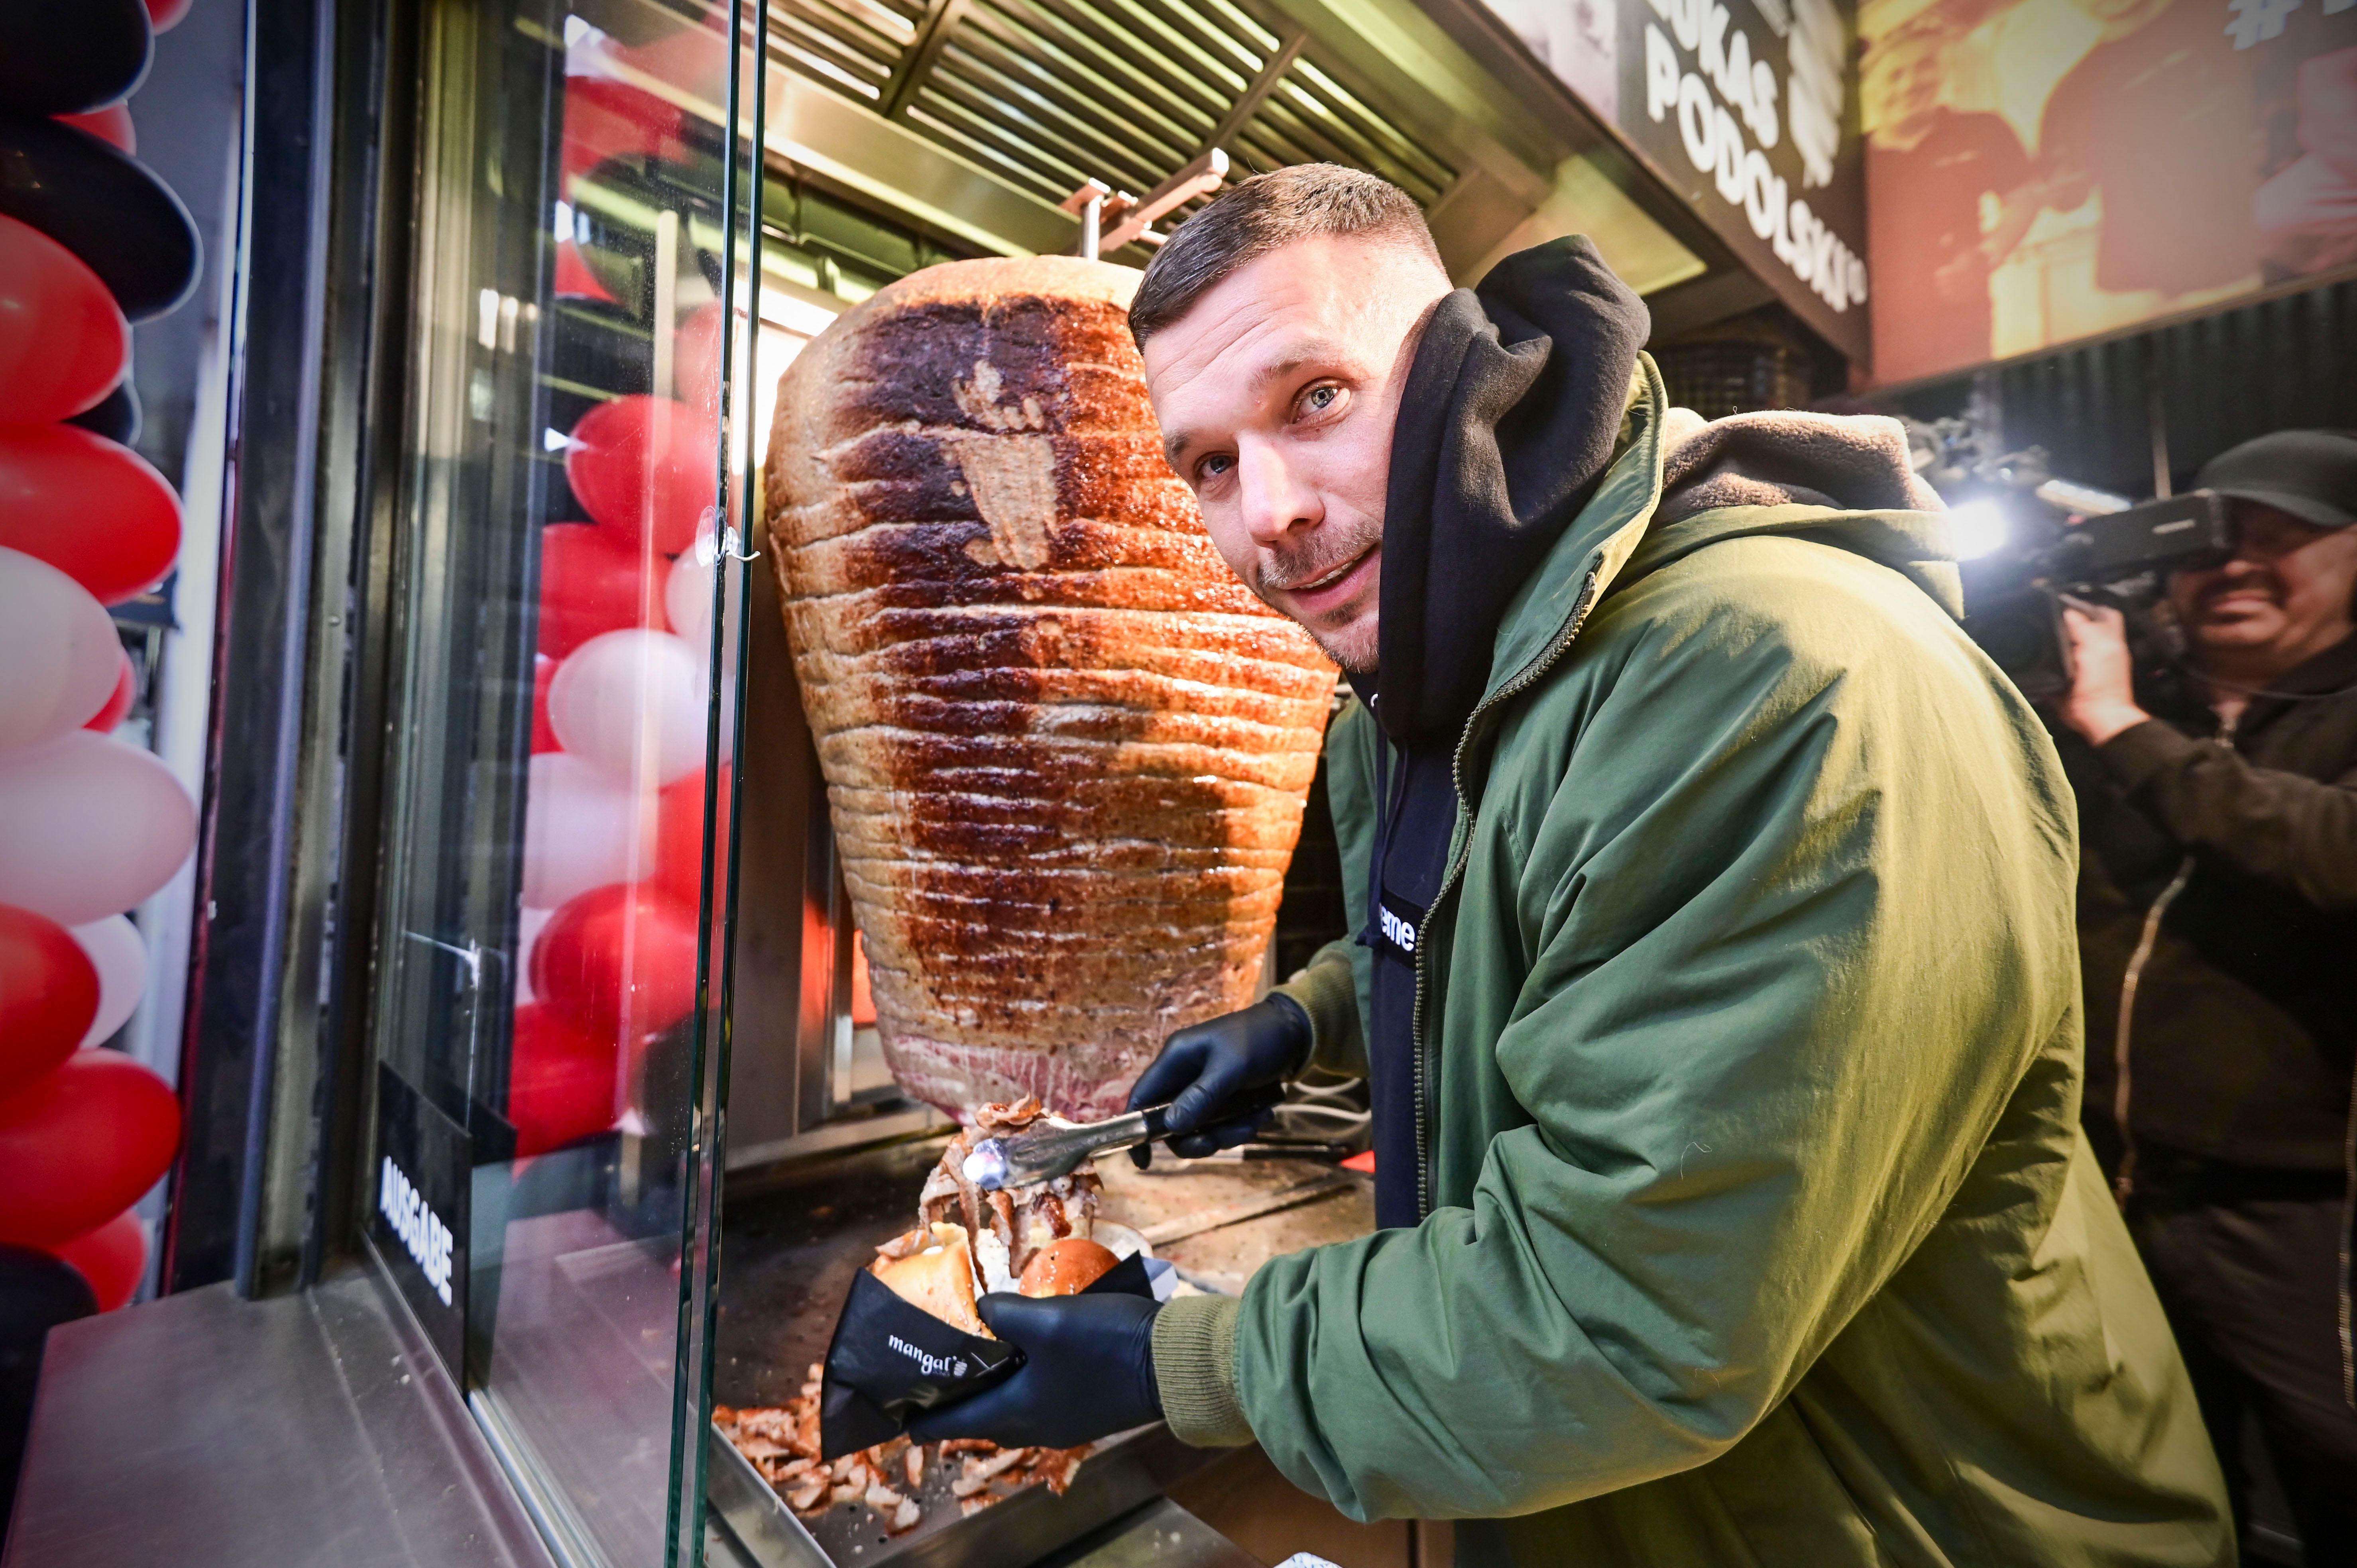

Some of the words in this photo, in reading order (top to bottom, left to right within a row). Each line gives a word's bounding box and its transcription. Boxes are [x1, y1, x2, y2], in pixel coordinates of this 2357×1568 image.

[1645, 0, 1779, 149] UKAS
[1380, 902, 1415, 951] eme
[380, 1155, 453, 1307] AUSGABE
